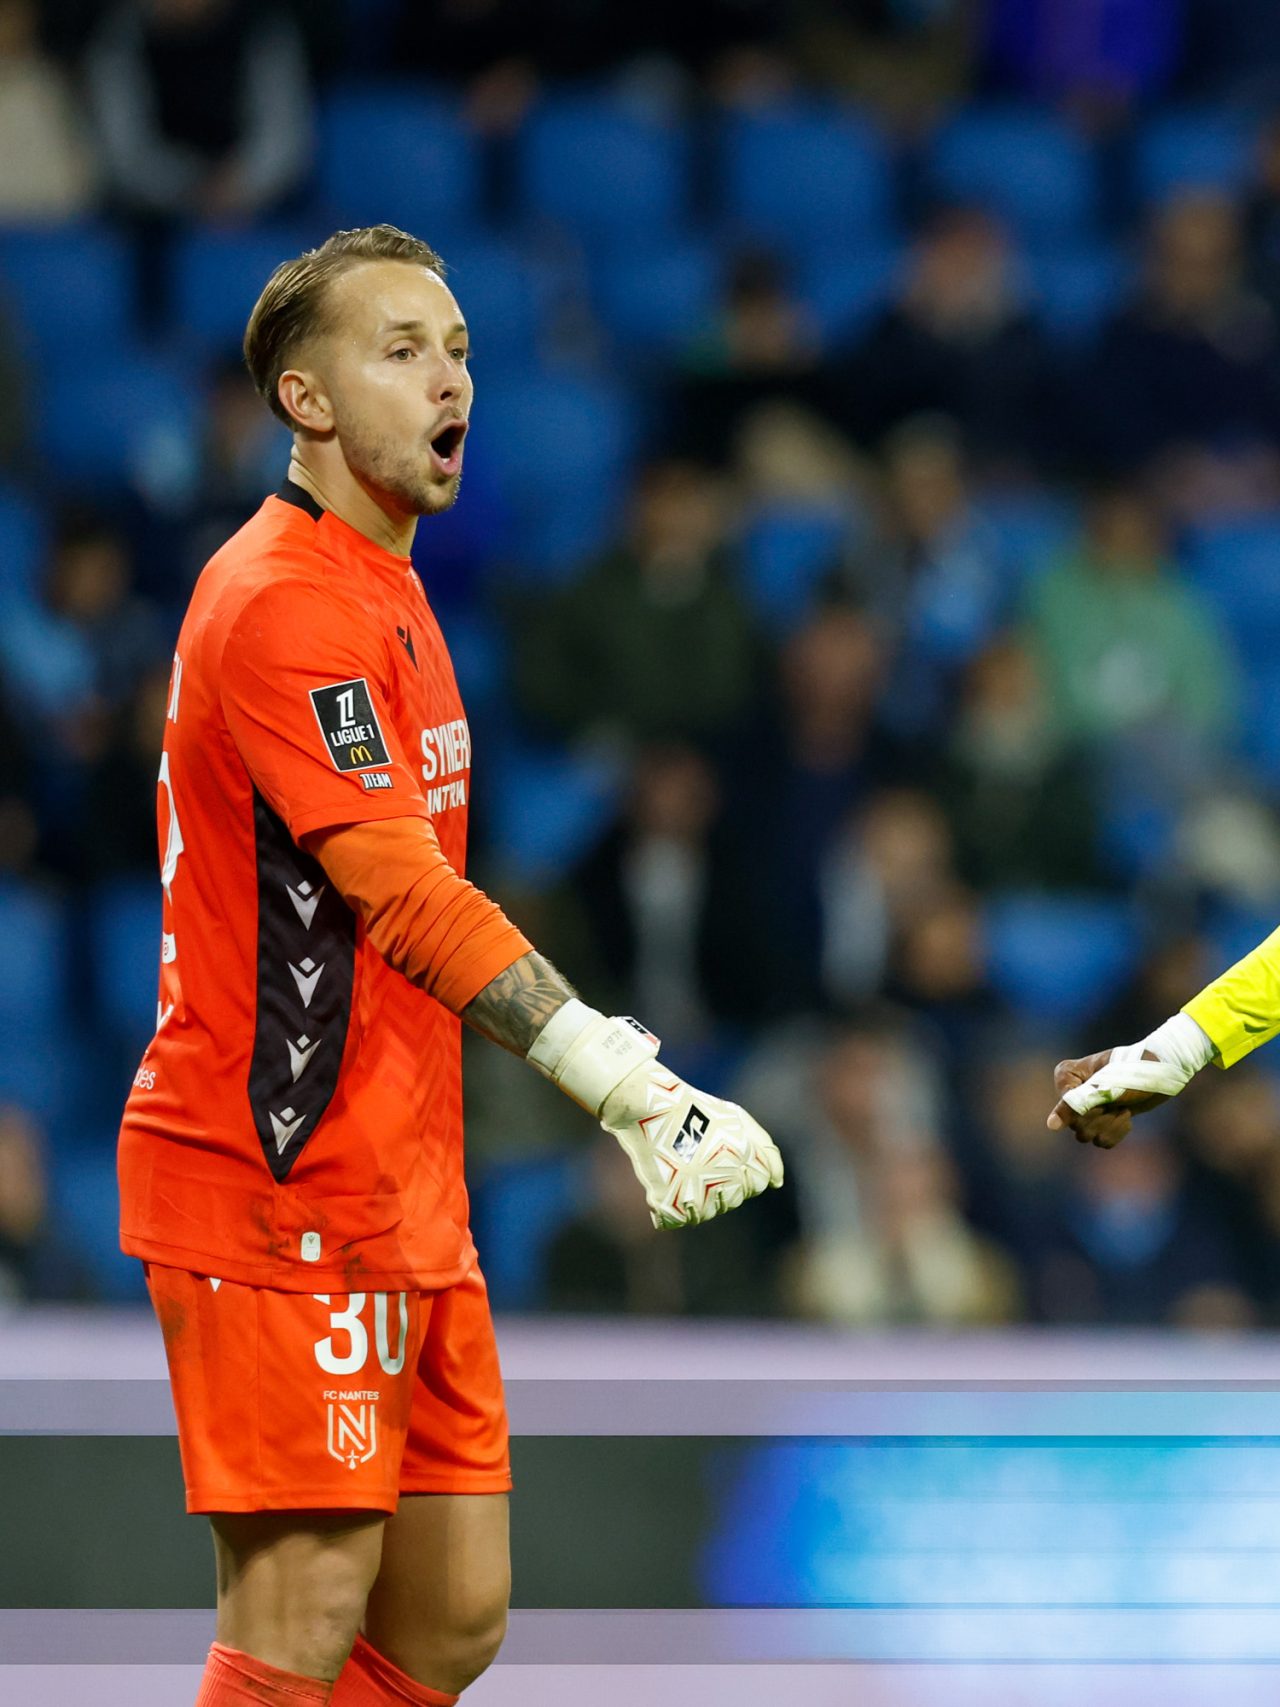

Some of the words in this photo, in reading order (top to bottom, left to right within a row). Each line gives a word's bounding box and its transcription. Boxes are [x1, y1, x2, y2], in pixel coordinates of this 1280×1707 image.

[330, 727, 368, 748] LIGUE
[312, 1291, 409, 1375] 30
[323, 1390, 337, 1401] FC
[338, 1390, 380, 1401] NANTES
